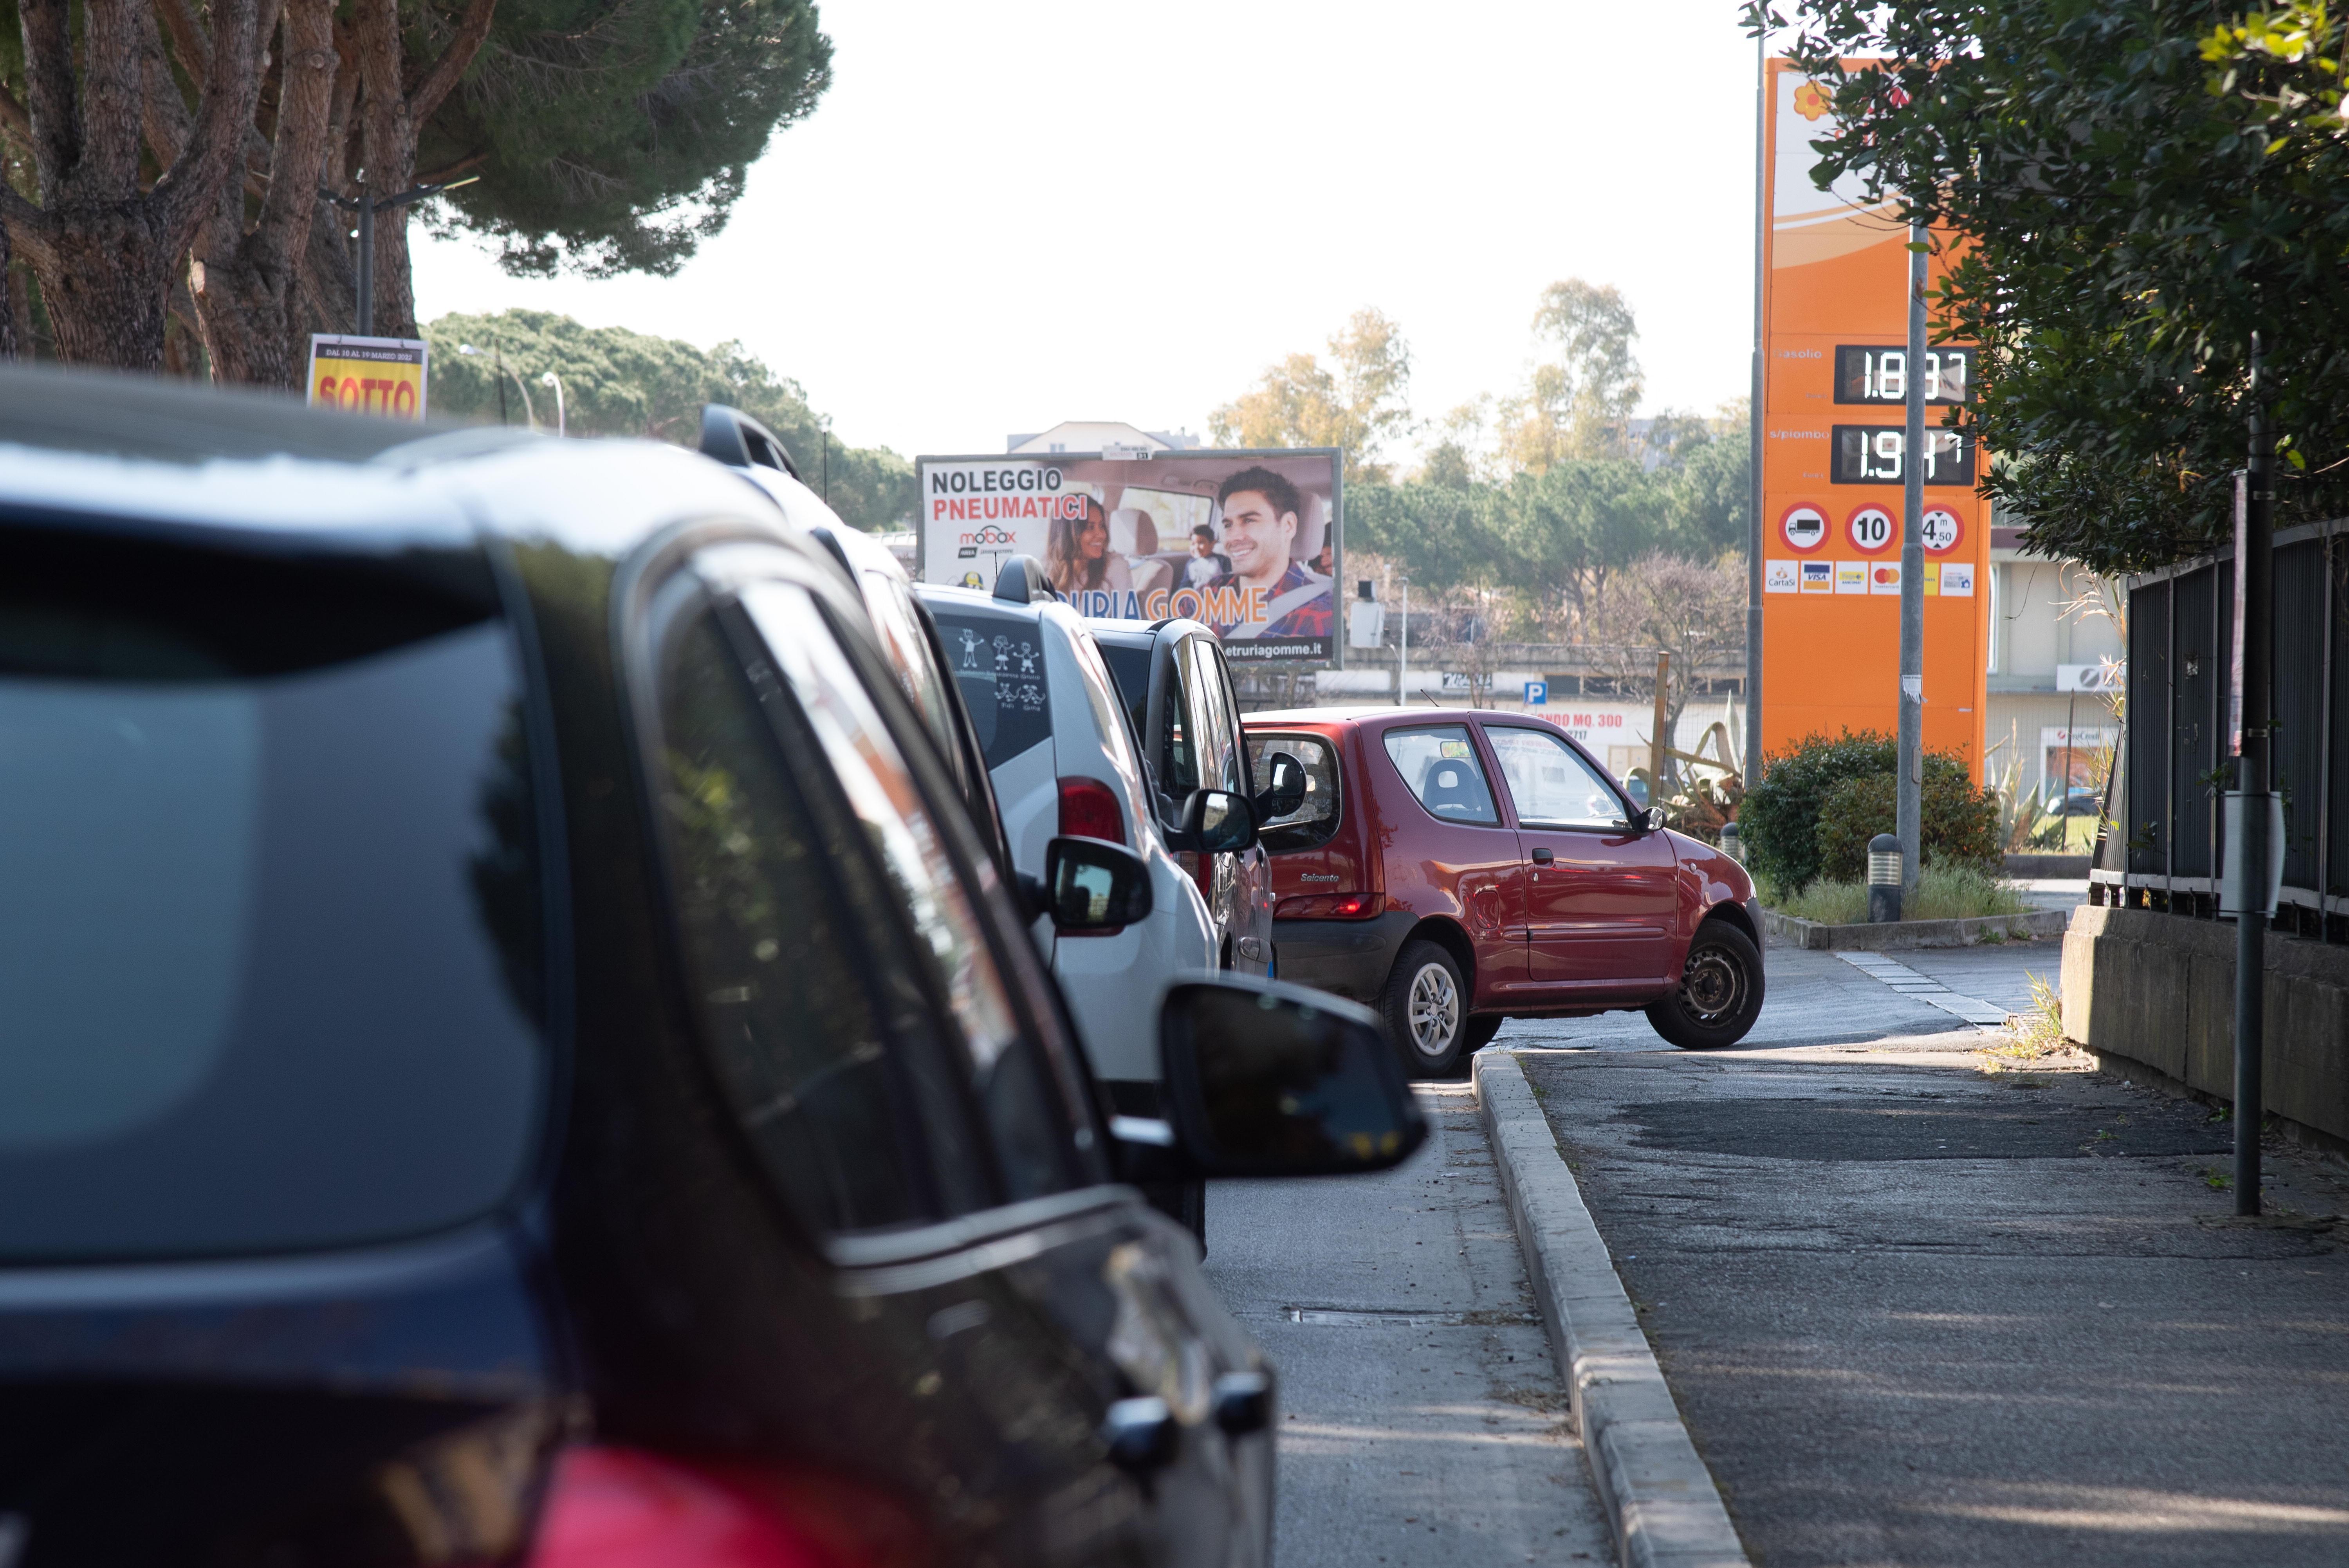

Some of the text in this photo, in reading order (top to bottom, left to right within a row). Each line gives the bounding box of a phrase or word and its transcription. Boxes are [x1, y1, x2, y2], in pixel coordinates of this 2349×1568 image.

[320, 375, 415, 417] SOTTO
[1770, 429, 1830, 441] s/piombo
[932, 469, 1062, 494] NOLEGGIO
[934, 496, 1087, 521] PNEUMATICI
[960, 528, 1017, 544] mobox
[1858, 517, 1885, 541] 10
[1528, 684, 1543, 703] P
[1573, 714, 1594, 727] MQ.
[1598, 715, 1622, 727] 300
[1301, 873, 1339, 882] Seicento
